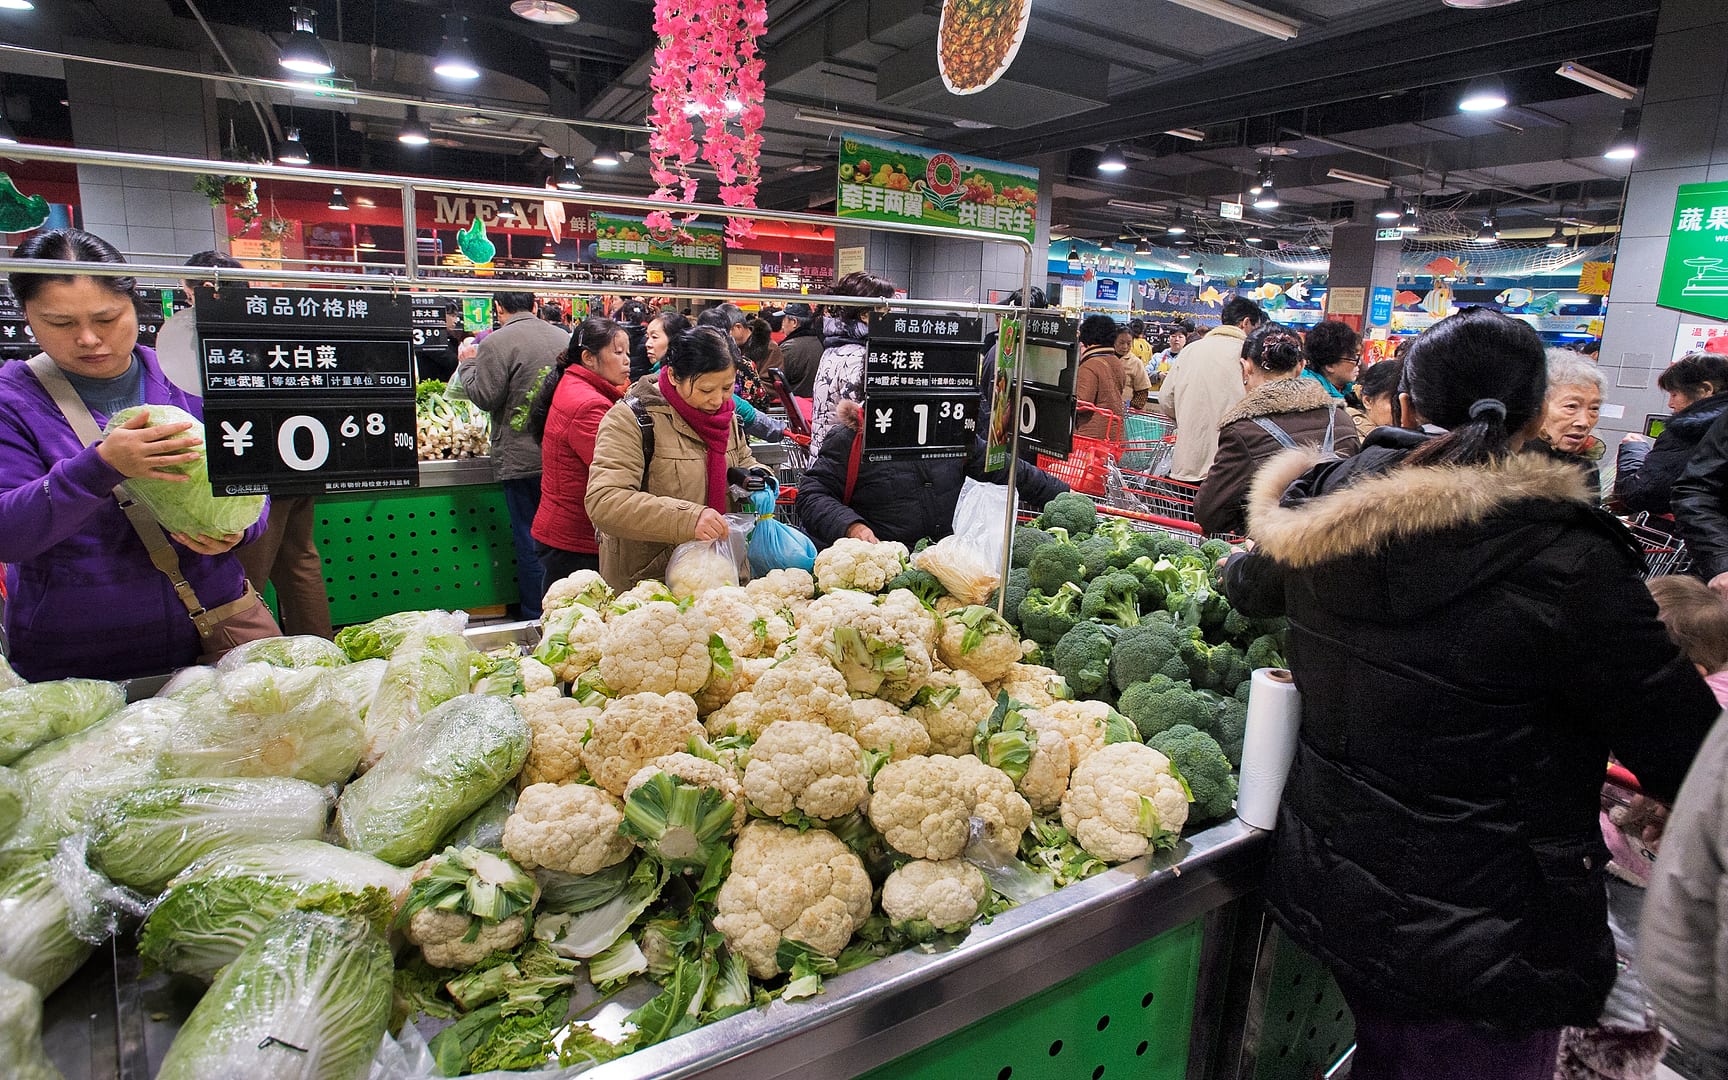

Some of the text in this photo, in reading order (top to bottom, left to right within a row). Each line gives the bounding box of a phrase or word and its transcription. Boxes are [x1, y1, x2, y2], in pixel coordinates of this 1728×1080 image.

[433, 195, 548, 231] MEAT
[841, 183, 1032, 234] 牵手两翼 共建民生
[1677, 206, 1728, 232] 蔬果
[245, 295, 369, 319] 商品价格牌
[894, 318, 960, 336] 商品价格牌
[208, 344, 338, 370] 品名: 大白菜
[891, 350, 925, 370] 花菜
[379, 375, 407, 387] 500g
[874, 407, 893, 434] ¥
[220, 420, 254, 457] ¥
[394, 432, 414, 450] 500g
